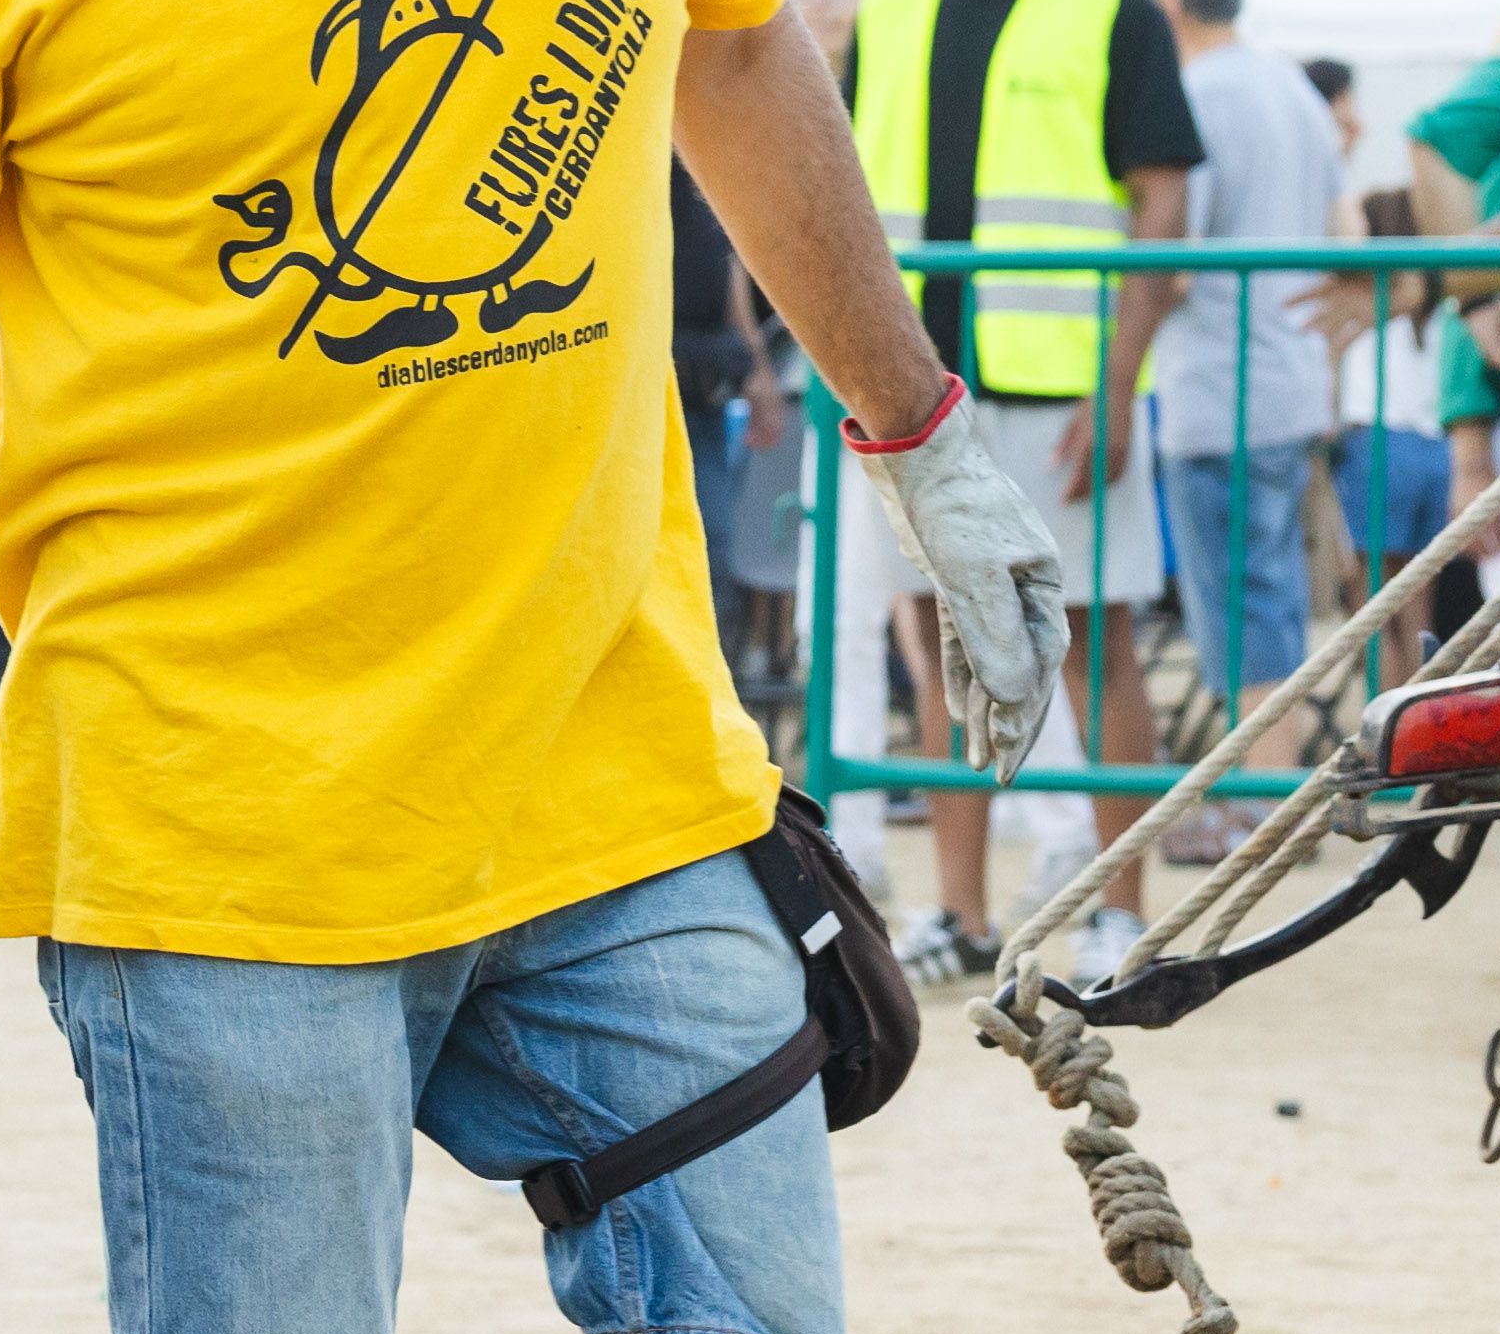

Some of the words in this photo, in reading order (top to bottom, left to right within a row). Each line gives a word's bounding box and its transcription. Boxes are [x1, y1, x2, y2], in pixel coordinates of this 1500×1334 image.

[464, 74, 579, 237] FURES
[546, 41, 594, 85] I
[549, 11, 652, 221] CERDANYOLA
[376, 318, 609, 390] diablescerdanyola.com
